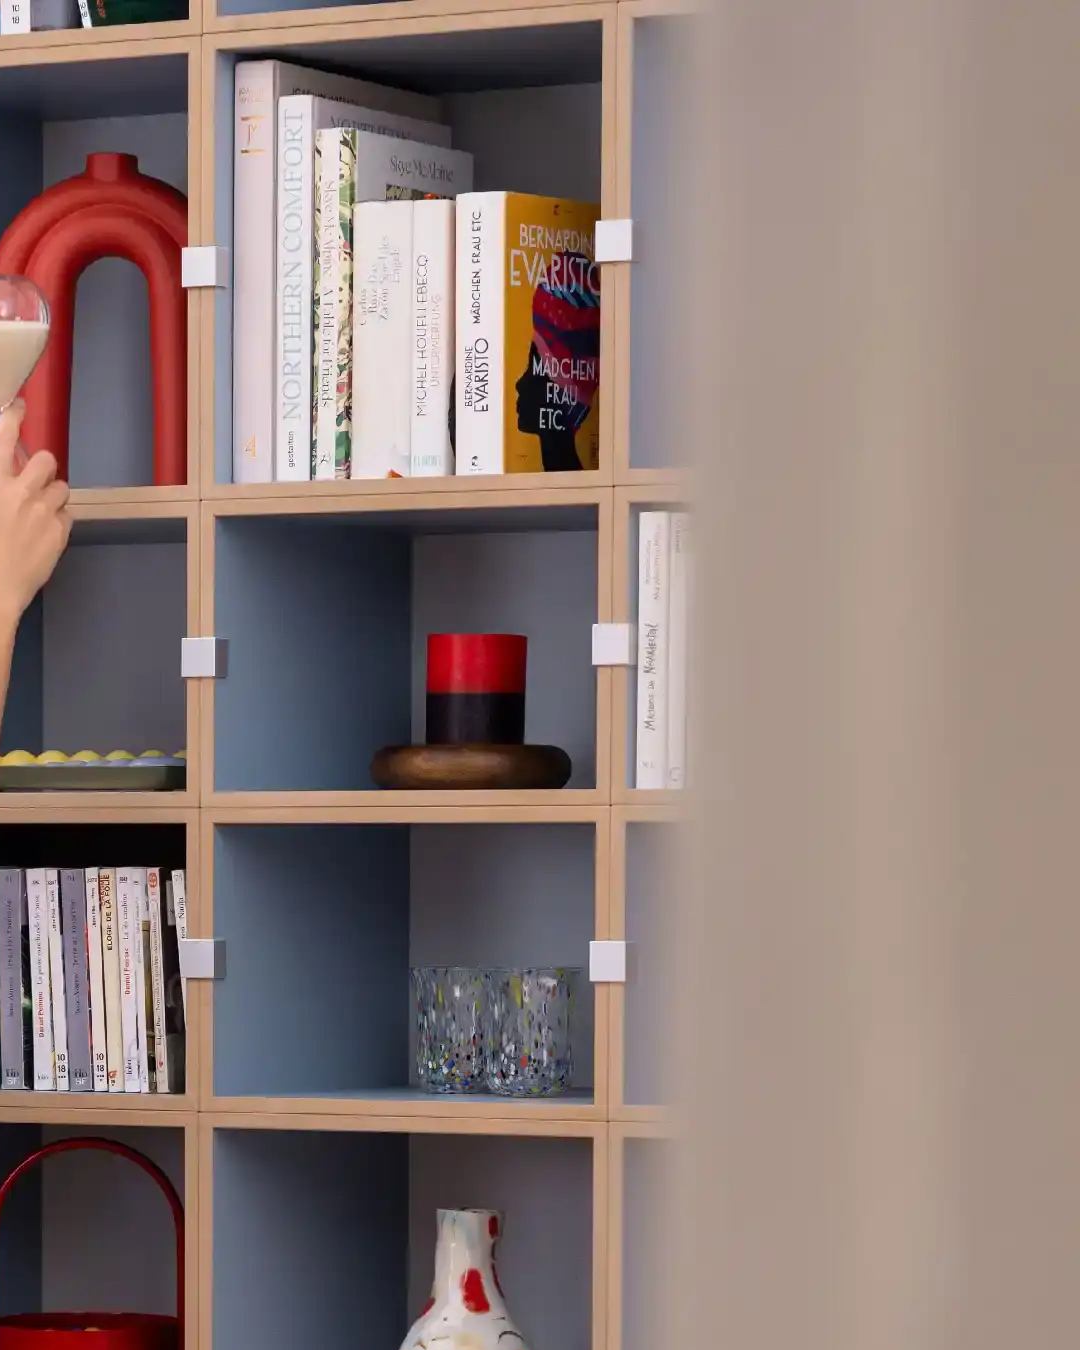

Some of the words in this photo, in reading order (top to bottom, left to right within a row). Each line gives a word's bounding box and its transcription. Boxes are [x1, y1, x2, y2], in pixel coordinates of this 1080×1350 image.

[11, 4, 20, 12] 10
[11, 16, 20, 24] 18
[390, 153, 412, 178] Skye
[283, 109, 304, 252] COMFORT
[471, 236, 482, 264] FRAU
[520, 223, 596, 253] BERNARDIN
[416, 254, 429, 359] HOUELLEBECQ
[470, 268, 482, 325] MÄDCHEN,
[321, 299, 335, 337] Table
[282, 261, 304, 421] NORTHERN
[321, 339, 334, 356] for
[430, 294, 441, 387] UNTERWERFUNG
[464, 345, 474, 407] BERNARDINE
[473, 337, 489, 412] EVARISTO
[532, 352, 598, 383] MÄDCHEN,
[319, 358, 333, 408] Friends
[416, 363, 427, 417] MICHEL
[546, 382, 579, 406] FRAU
[539, 407, 567, 431] ETC.
[286, 430, 296, 468] gestalten
[105, 898, 111, 909] LA
[105, 911, 112, 922] DE
[57, 1053, 66, 1062] 10
[57, 1065, 66, 1073] 18
[95, 1052, 104, 1061] 10
[96, 1064, 105, 1072] 18
